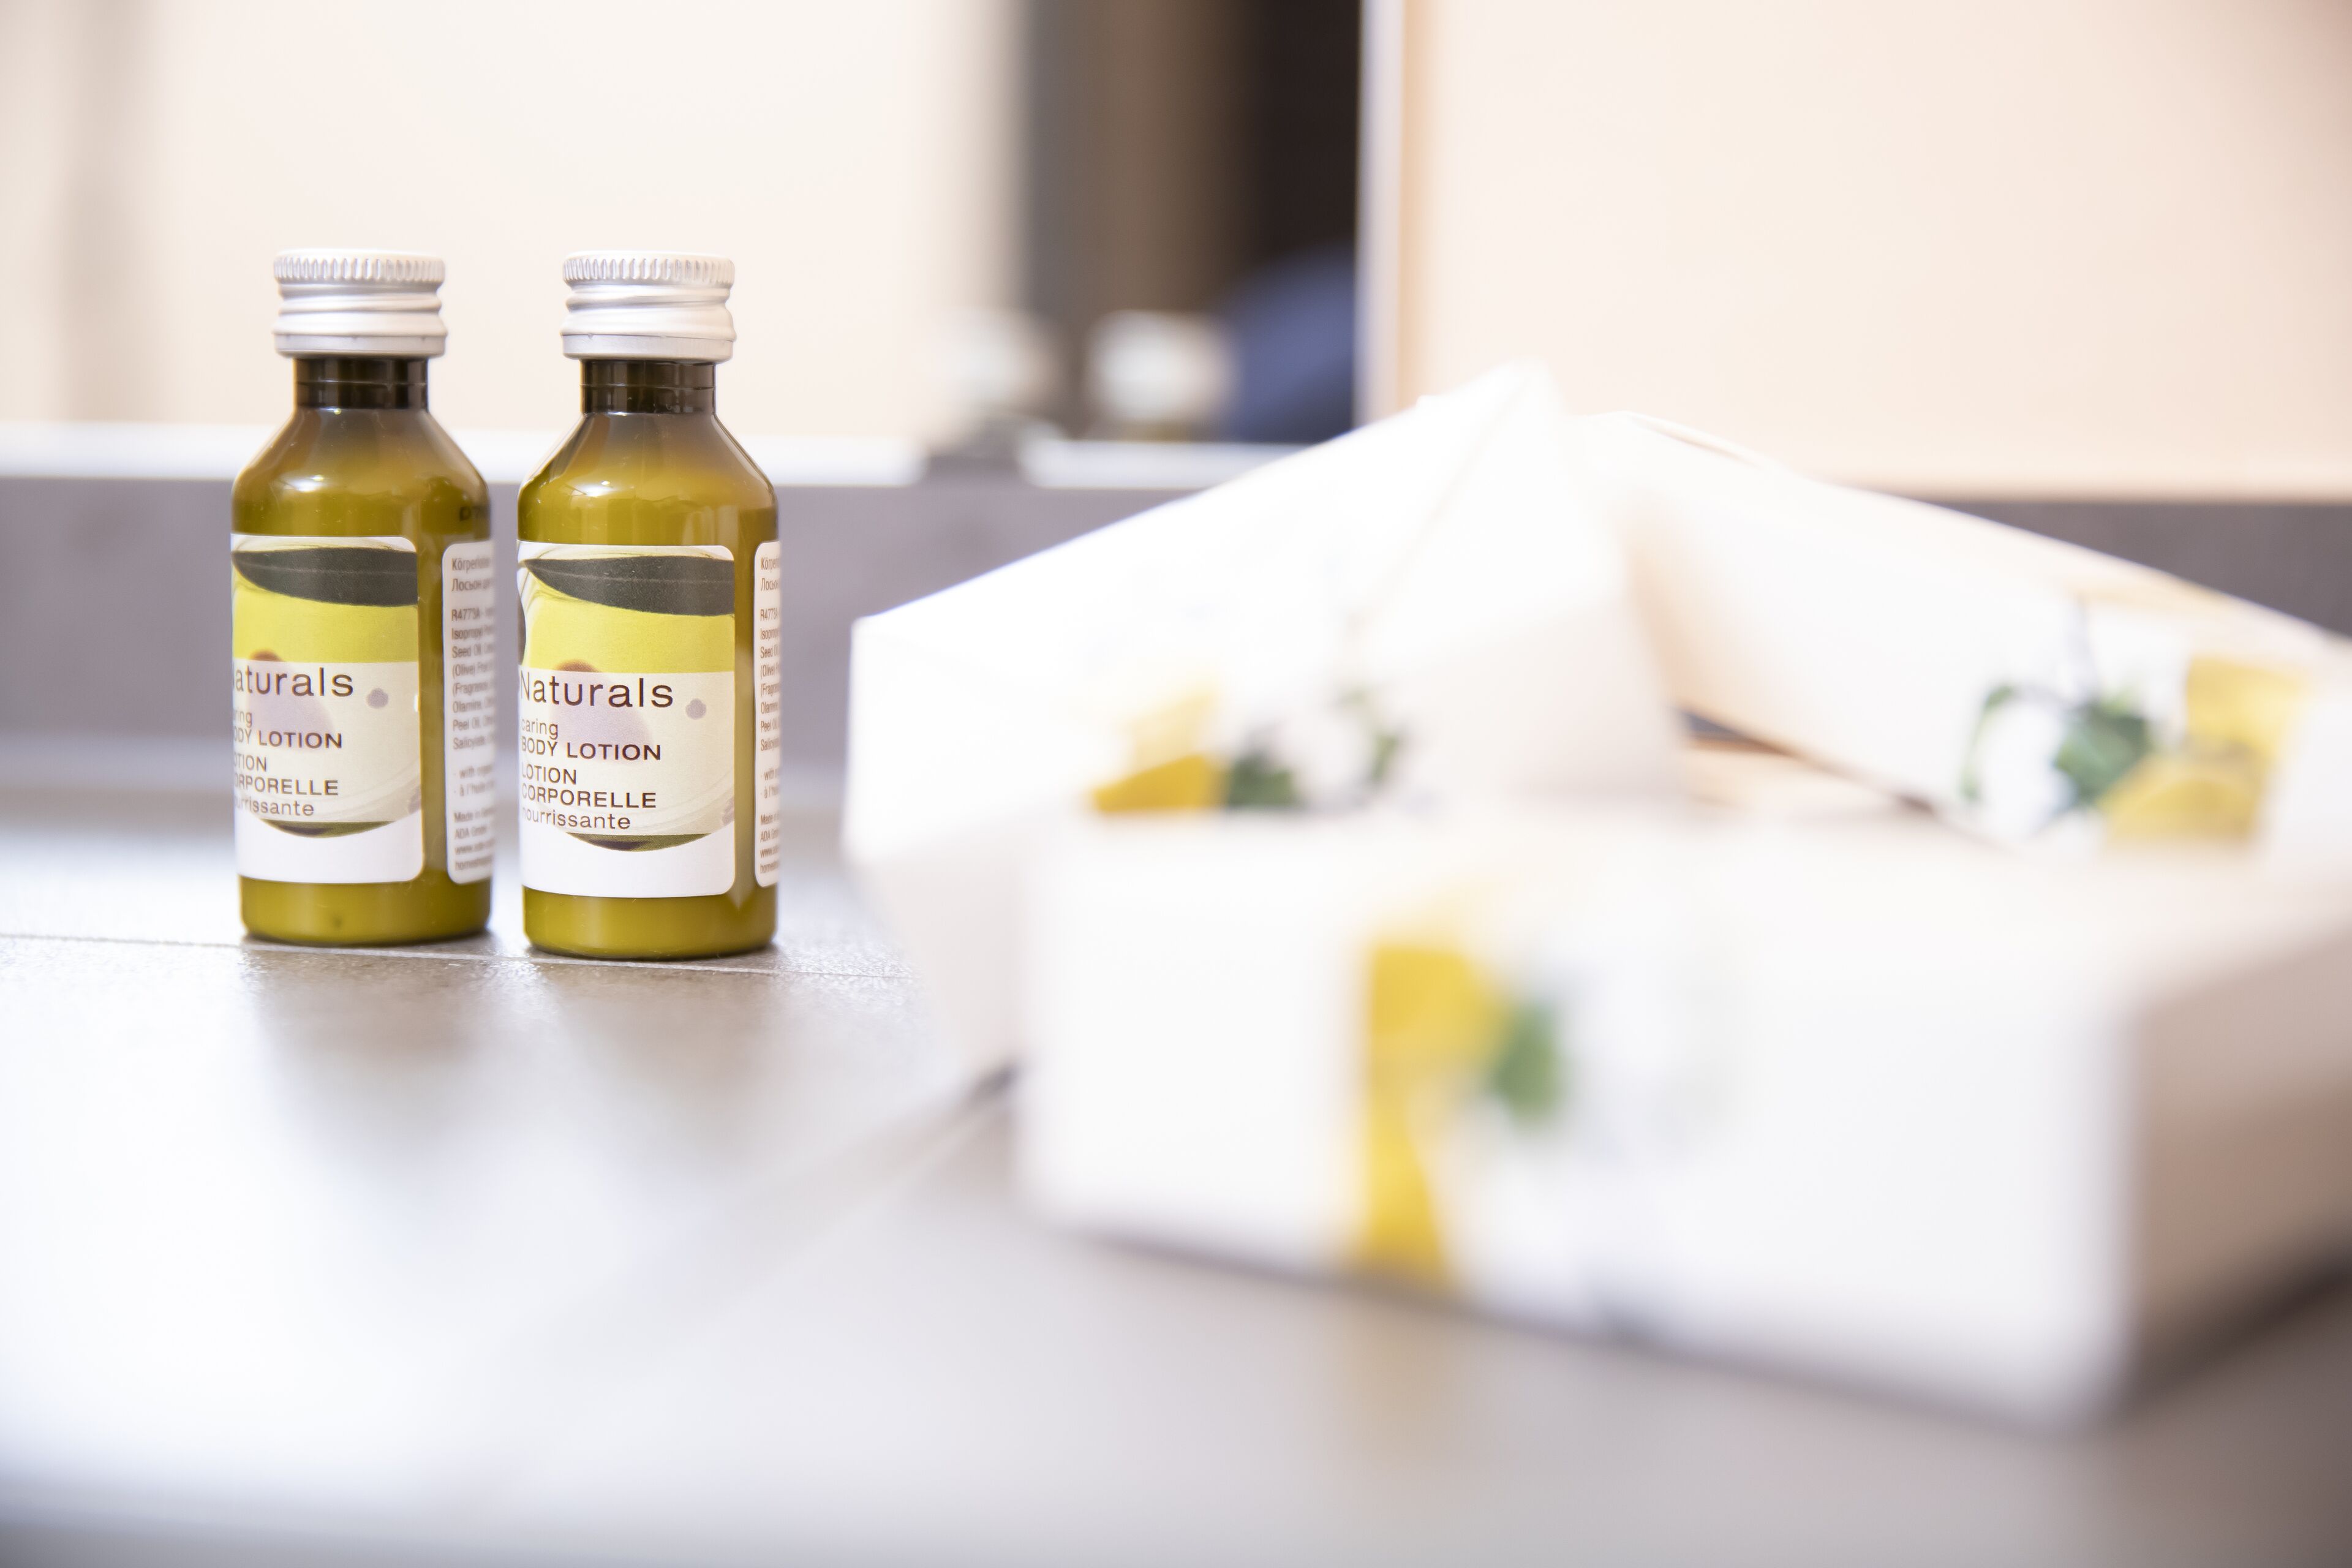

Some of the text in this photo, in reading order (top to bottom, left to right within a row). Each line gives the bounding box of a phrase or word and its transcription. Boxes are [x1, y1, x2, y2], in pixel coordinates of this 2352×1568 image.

[233, 665, 353, 697] aturals
[521, 671, 673, 707] Naturals
[257, 729, 342, 749] LOTION
[521, 718, 558, 741] caring
[521, 736, 661, 761] BODY LOTION
[235, 772, 339, 796] ORPORELLE
[522, 762, 577, 785] LOTION
[522, 783, 656, 809] CORPORELLE
[522, 807, 630, 830] nourrissante
